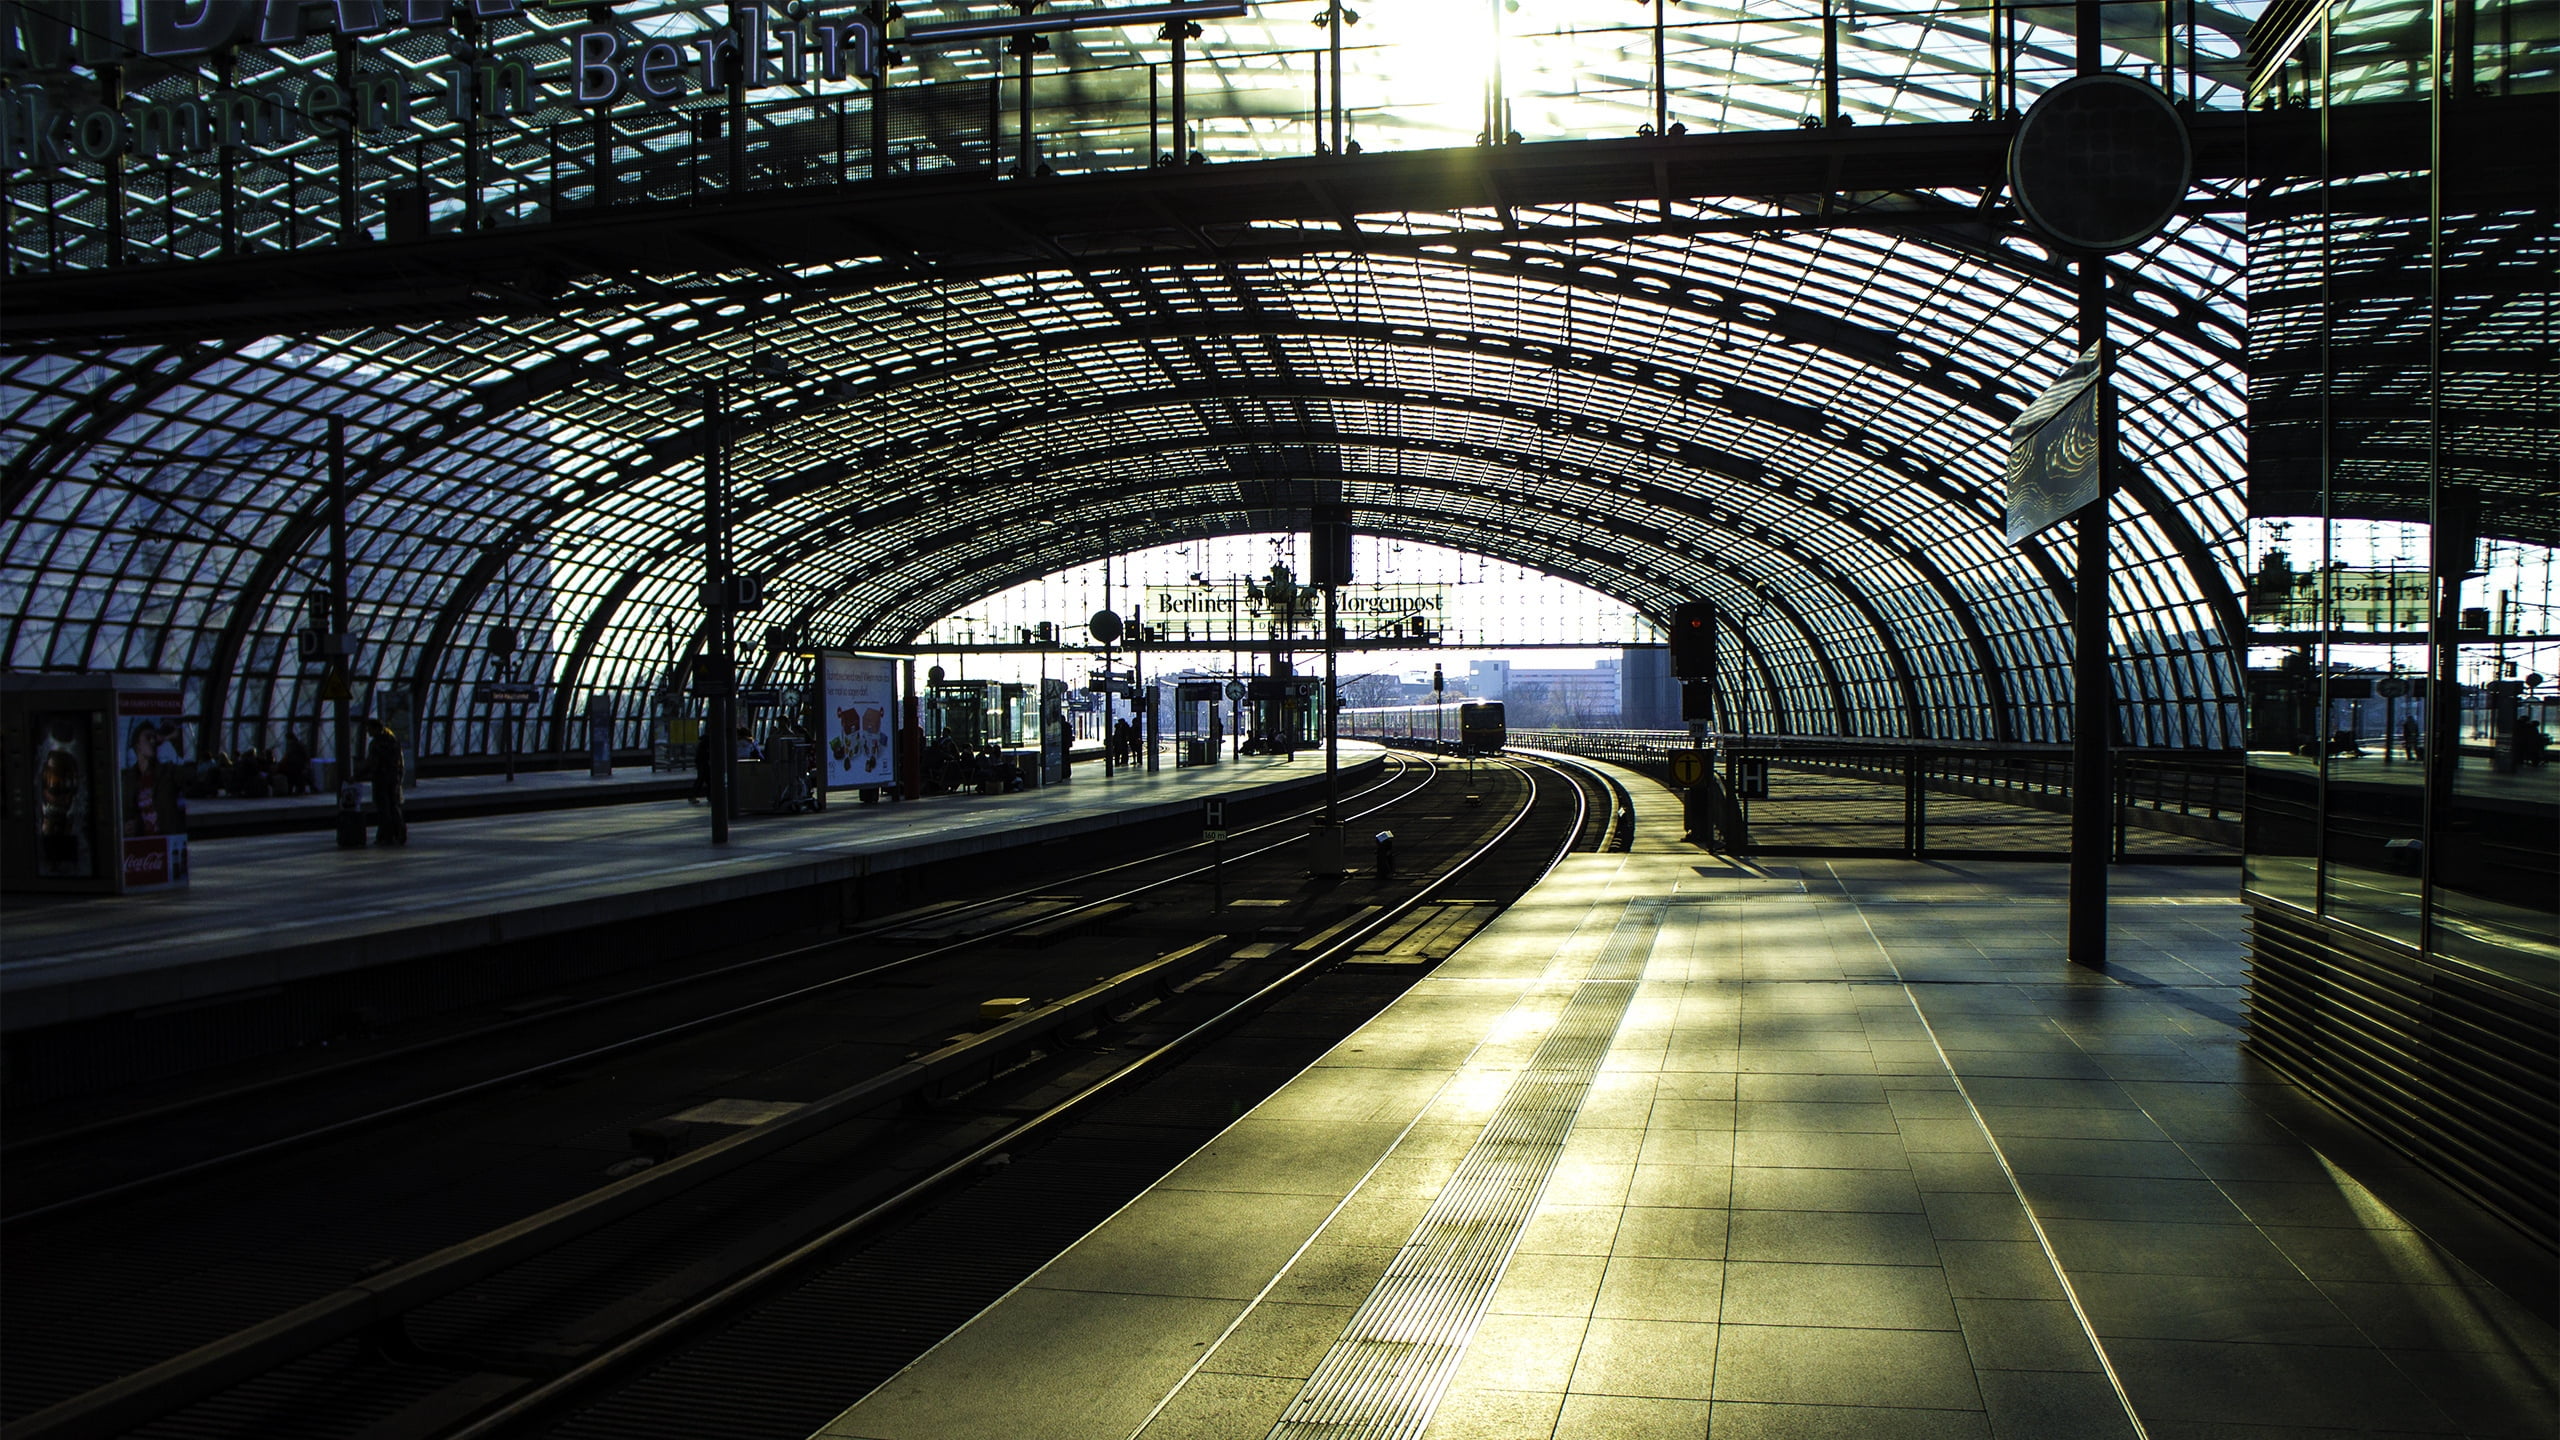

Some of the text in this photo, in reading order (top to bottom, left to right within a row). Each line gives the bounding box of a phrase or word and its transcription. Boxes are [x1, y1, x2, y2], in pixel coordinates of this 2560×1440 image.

[441, 38, 536, 122] in
[572, 0, 881, 102] Berlin
[738, 577, 757, 603] D
[1158, 592, 1234, 613] Berliner
[302, 631, 318, 654] D
[1299, 685, 1307, 695] C
[1742, 763, 1762, 792] H
[1207, 801, 1222, 825] H
